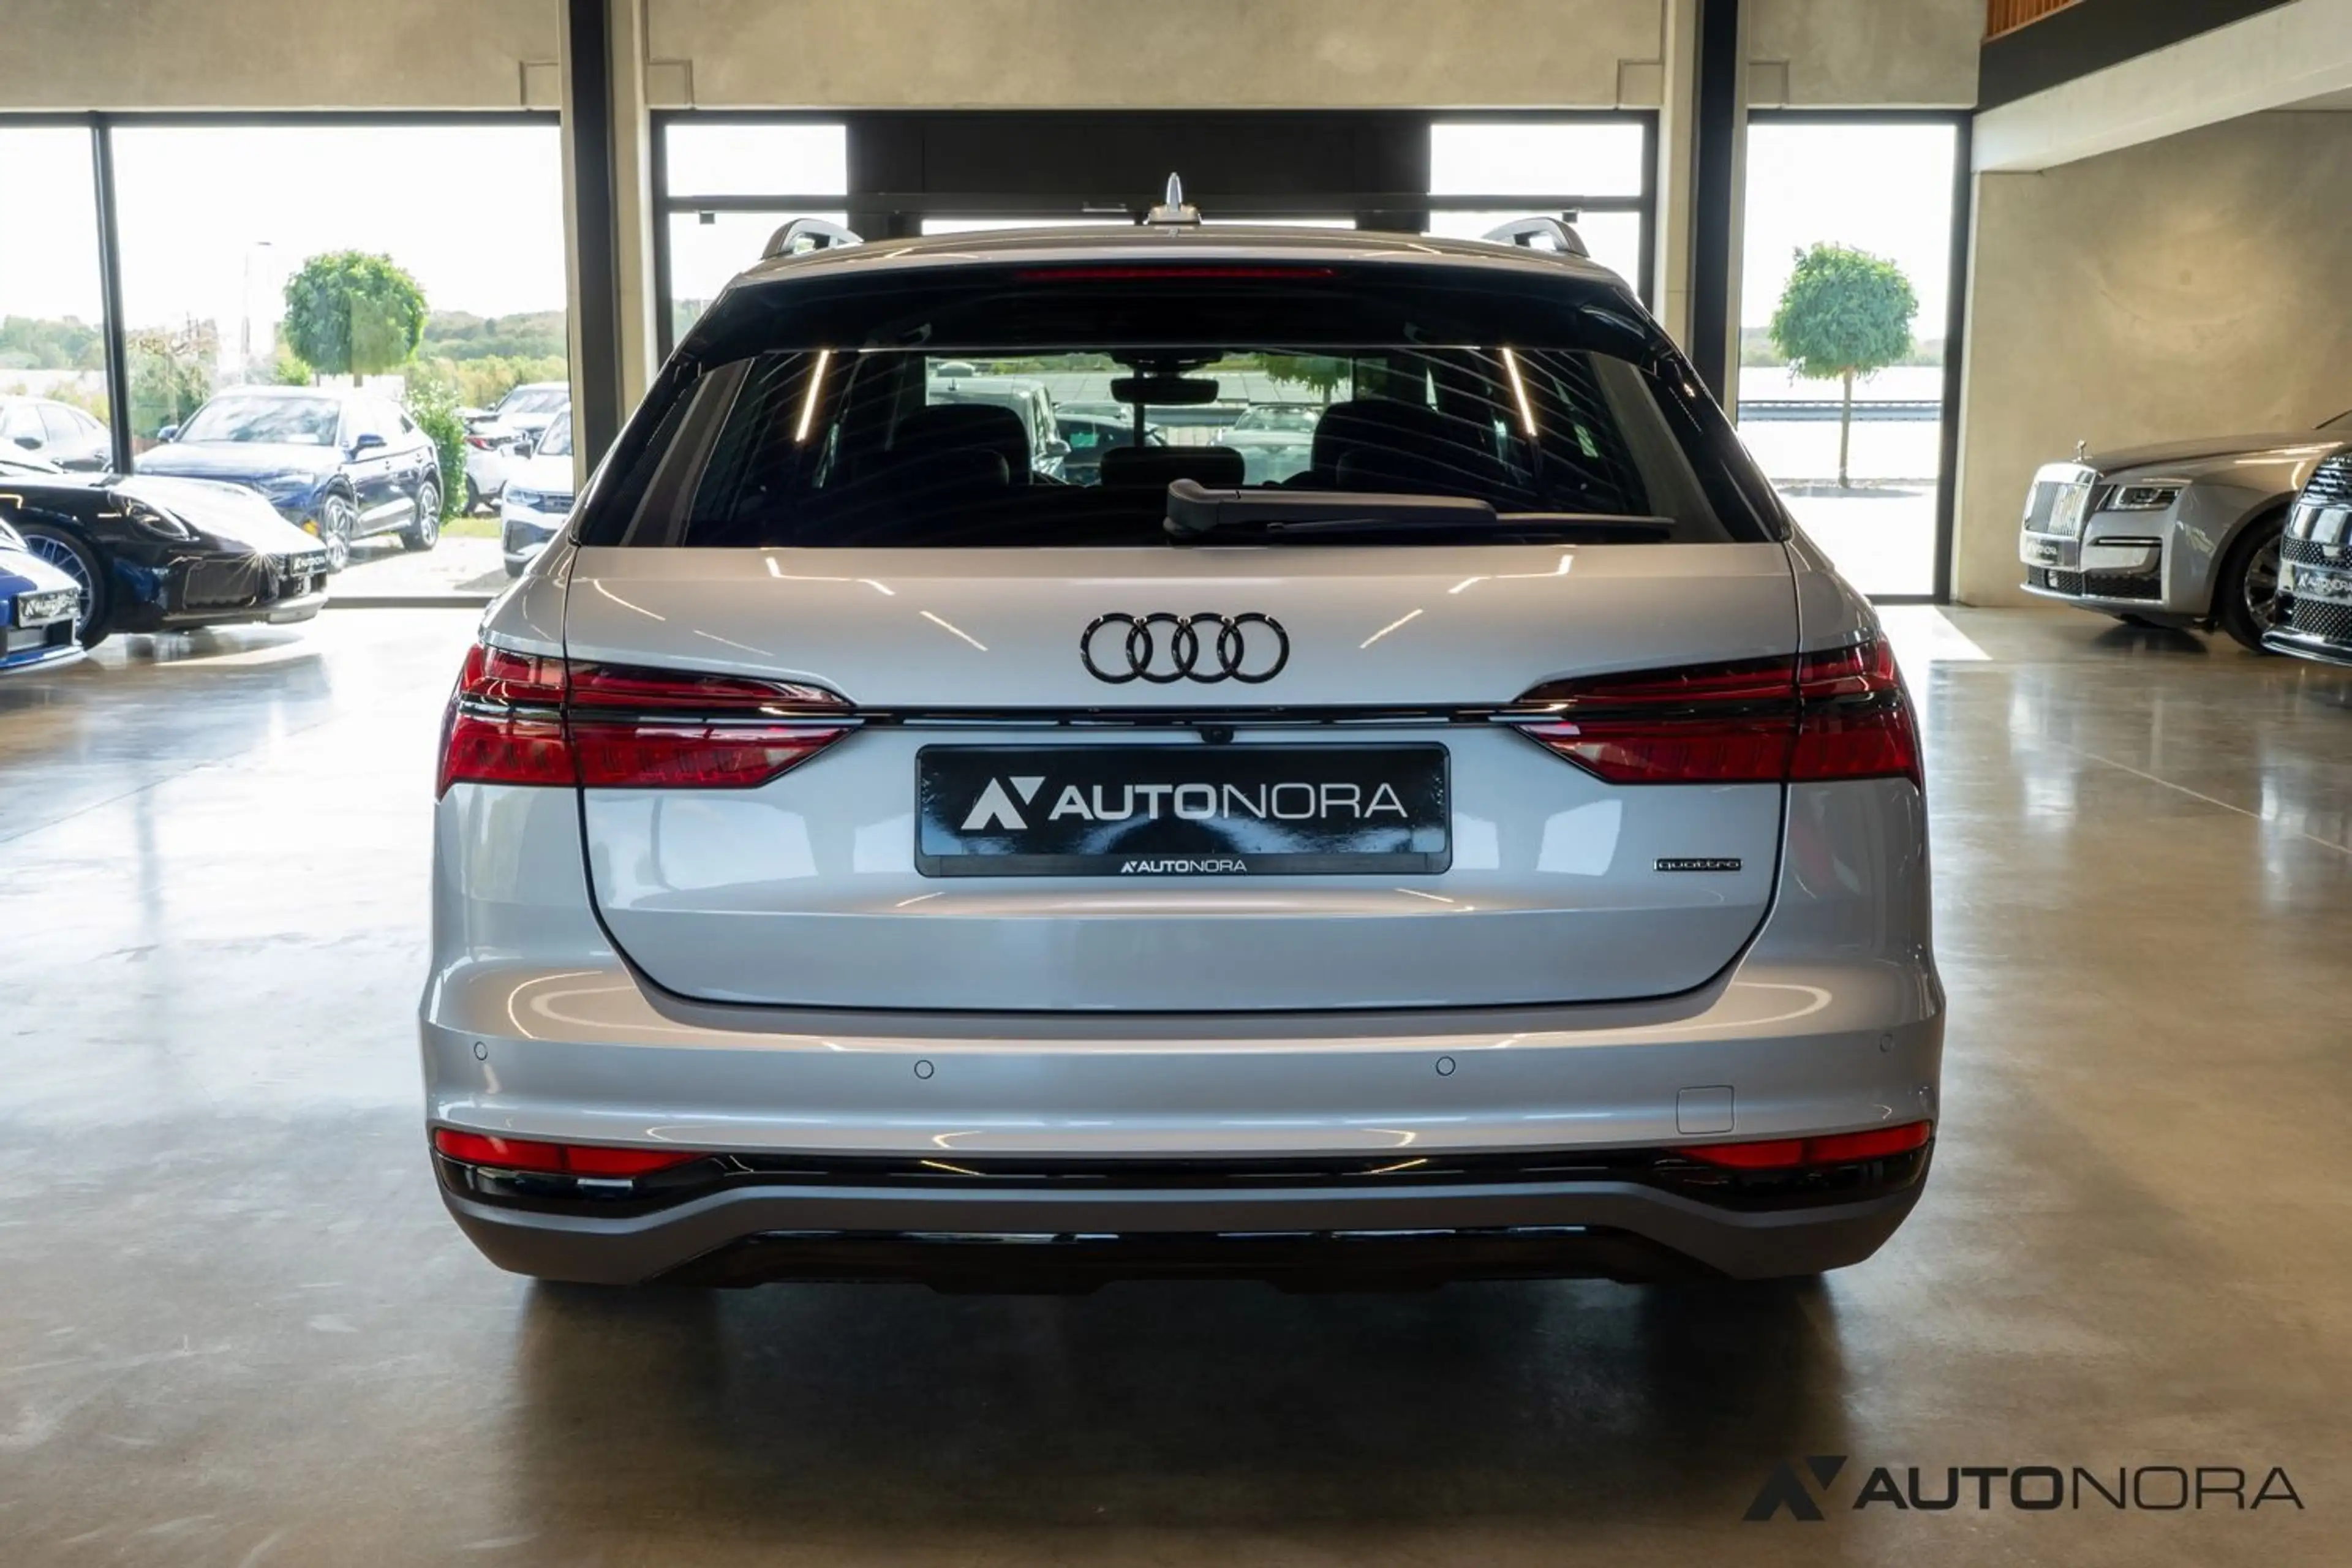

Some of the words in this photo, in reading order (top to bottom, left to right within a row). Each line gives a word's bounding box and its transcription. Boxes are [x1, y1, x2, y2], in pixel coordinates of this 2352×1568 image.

[1047, 783, 1408, 820] AUTONORA
[1137, 859, 1248, 873] AUTONORA
[1658, 860, 1740, 870] quattro
